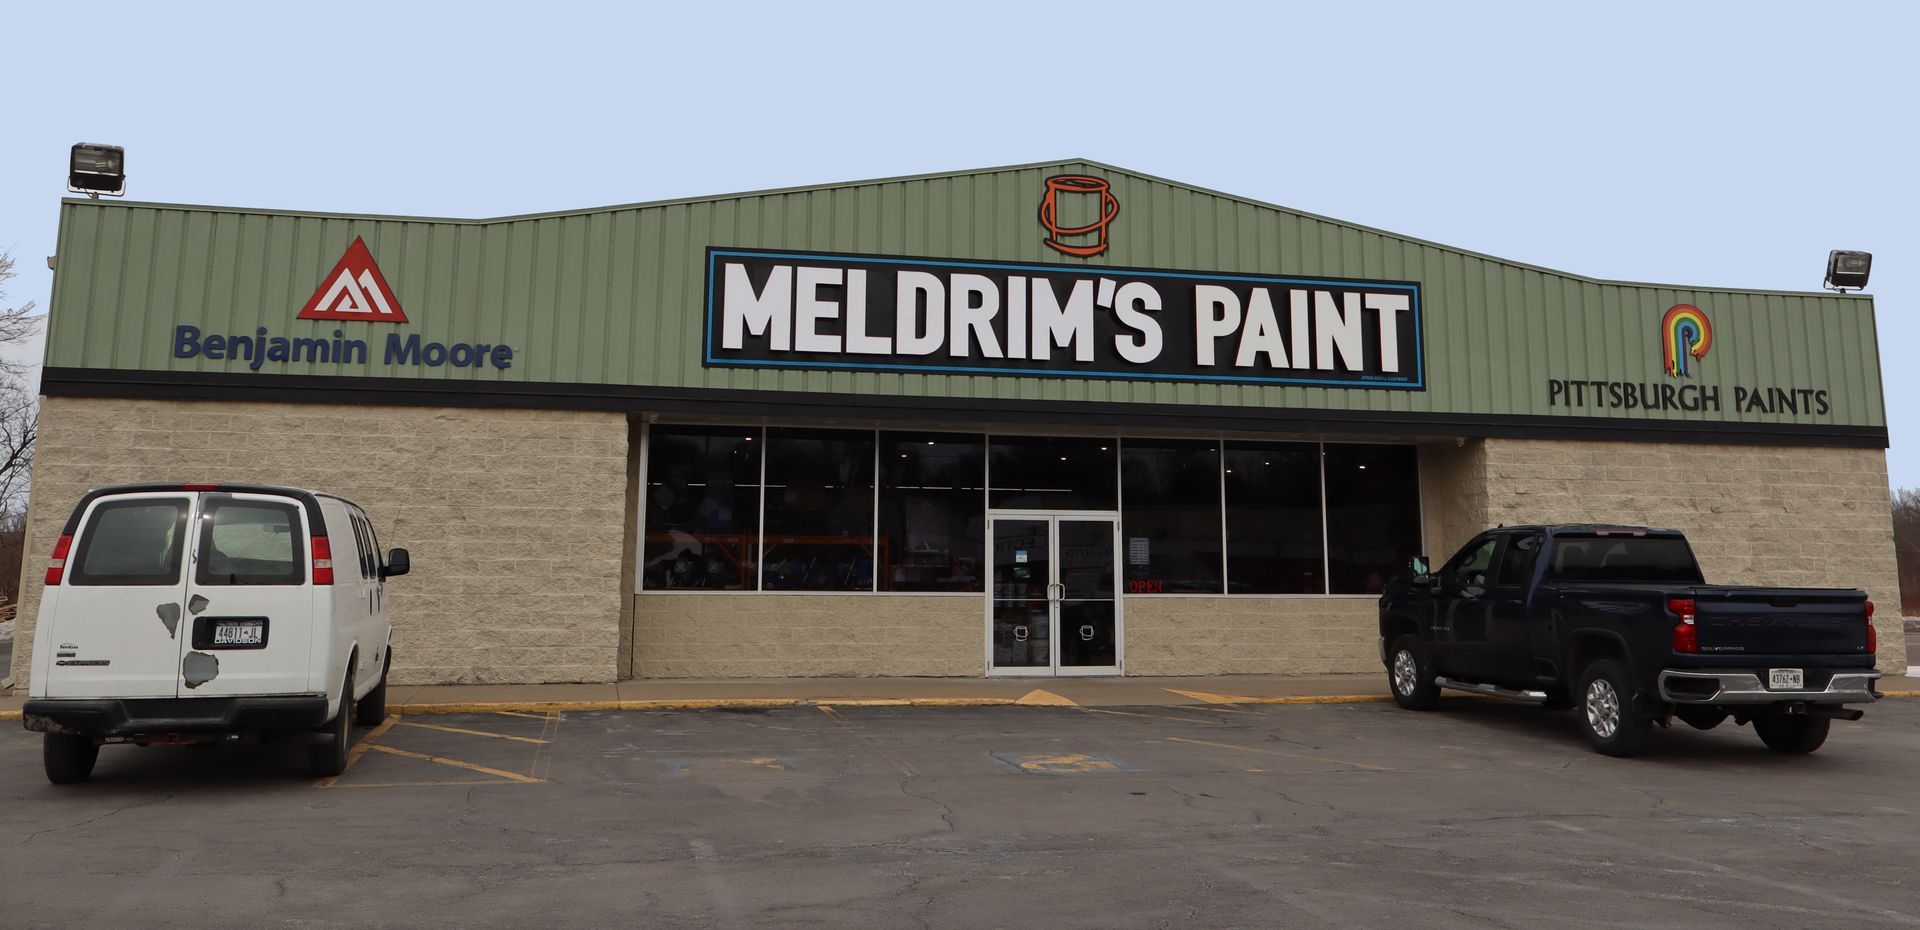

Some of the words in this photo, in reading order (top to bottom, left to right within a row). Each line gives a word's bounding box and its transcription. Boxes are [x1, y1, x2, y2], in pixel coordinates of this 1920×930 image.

[722, 261, 1163, 365] MELDRIM'S
[1195, 284, 1410, 373] PAINT
[173, 324, 367, 370] Benjamin
[384, 333, 514, 369] Moore
[1548, 379, 1721, 412] PITTSBURGH
[1734, 386, 1830, 415] PAINTS
[1129, 579, 1164, 593] OPEN
